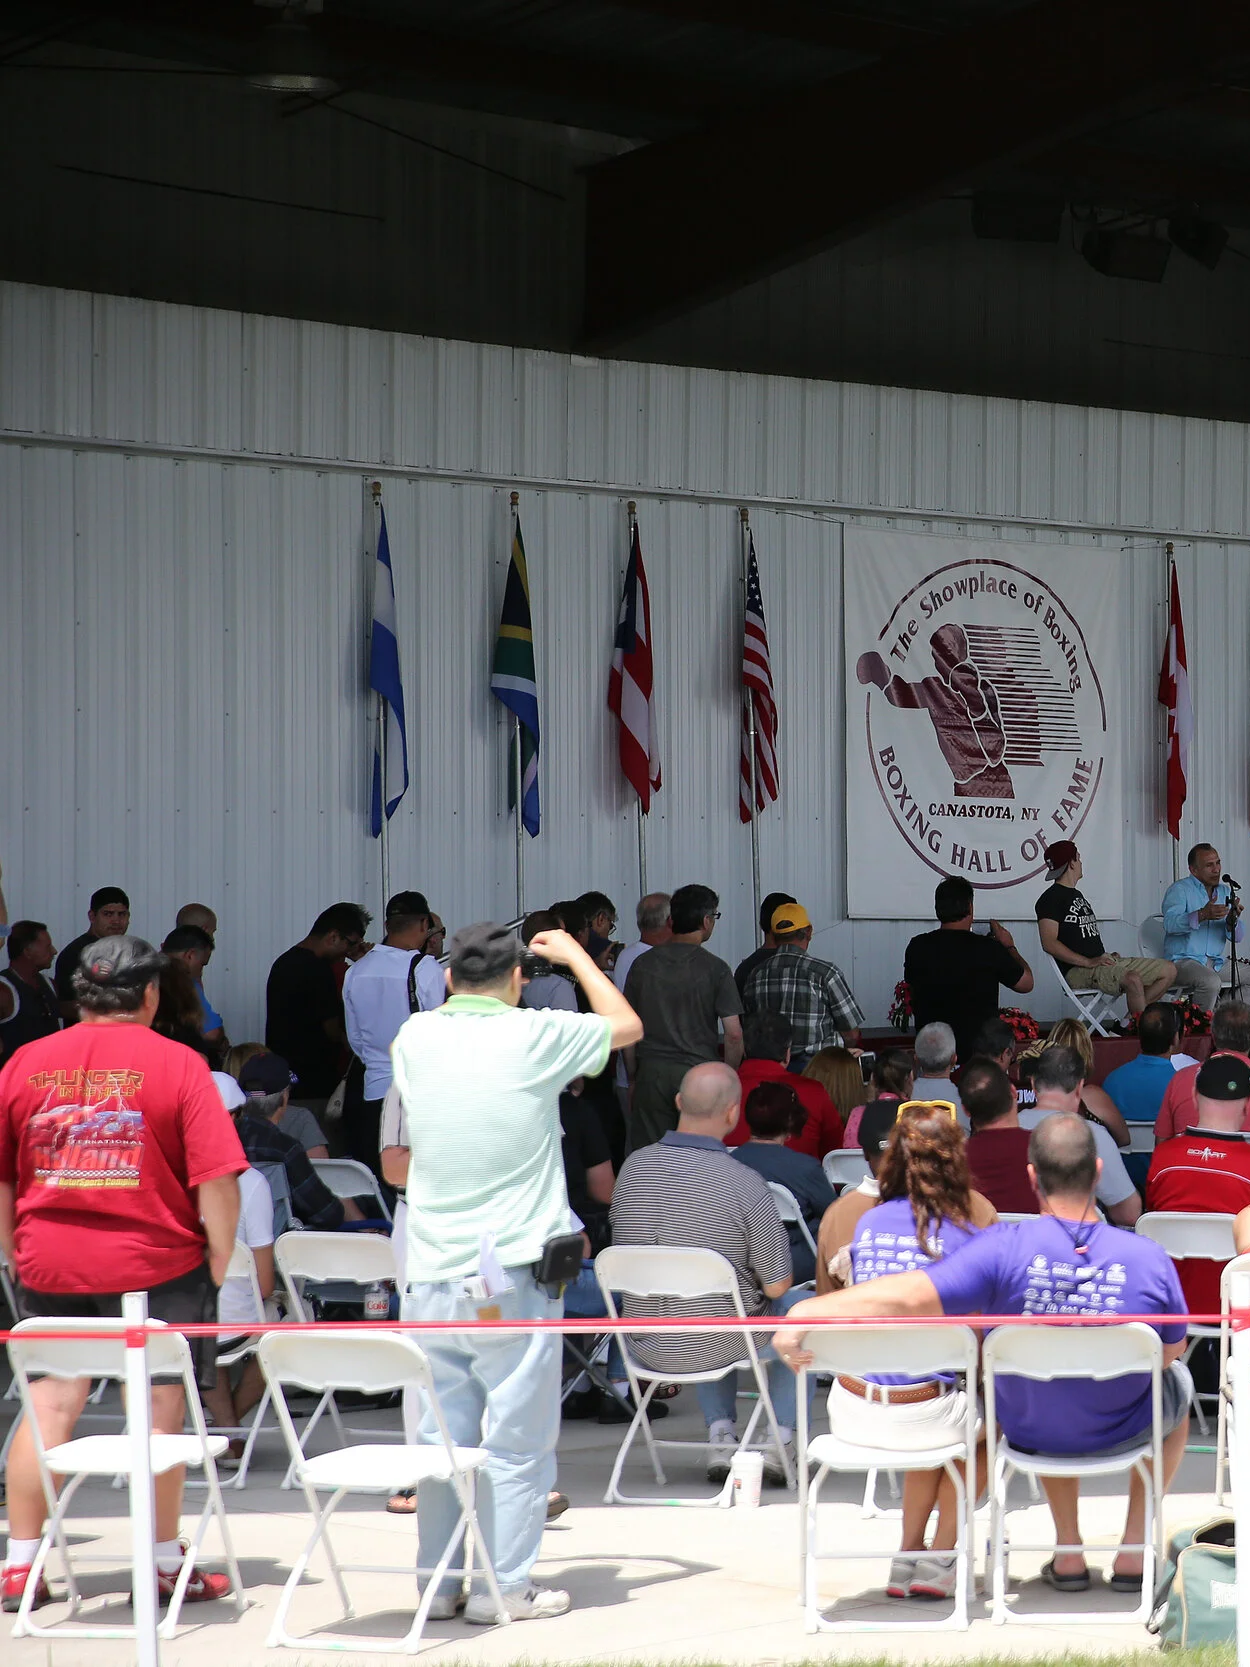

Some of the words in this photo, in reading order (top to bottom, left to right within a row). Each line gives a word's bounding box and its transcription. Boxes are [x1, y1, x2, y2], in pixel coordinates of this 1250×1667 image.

[889, 617, 919, 664] The
[919, 570, 1018, 622] Showplace
[1023, 591, 1045, 615] of
[1042, 606, 1083, 694] Boxing
[878, 744, 943, 854] BOXING
[951, 843, 1012, 874] HALL
[1020, 827, 1050, 862] OF
[1051, 757, 1094, 832] FAME
[928, 802, 1016, 822] CANASTOTA,
[1021, 807, 1041, 822] NY
[29, 1066, 144, 1089] THUNDER
[59, 1086, 74, 1099] IN
[366, 1300, 389, 1312] Coke
